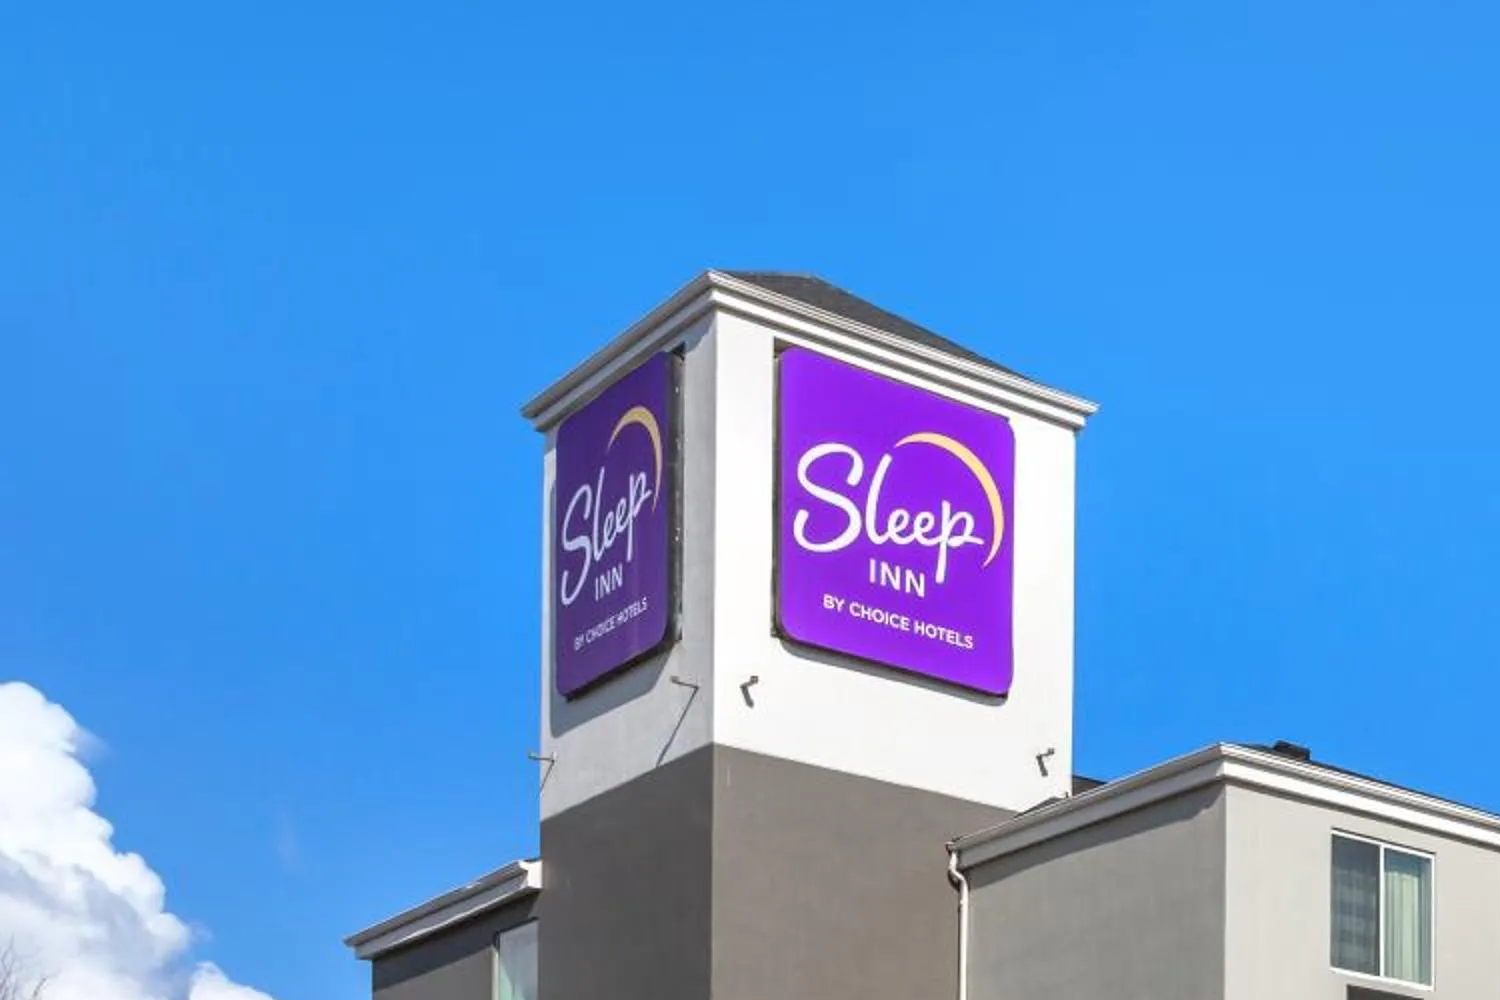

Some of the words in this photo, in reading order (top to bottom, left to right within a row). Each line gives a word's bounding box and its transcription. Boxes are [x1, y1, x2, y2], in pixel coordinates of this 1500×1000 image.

[561, 466, 653, 606] Sleep
[793, 442, 984, 583] Sleep
[595, 563, 624, 601] INN
[869, 557, 925, 598] INN
[574, 633, 585, 651] BY
[585, 615, 615, 643] CHOICE
[617, 596, 648, 624] HOTELS
[823, 594, 845, 612] BY
[849, 602, 910, 631] CHOICE
[914, 620, 974, 649] HOTELS
